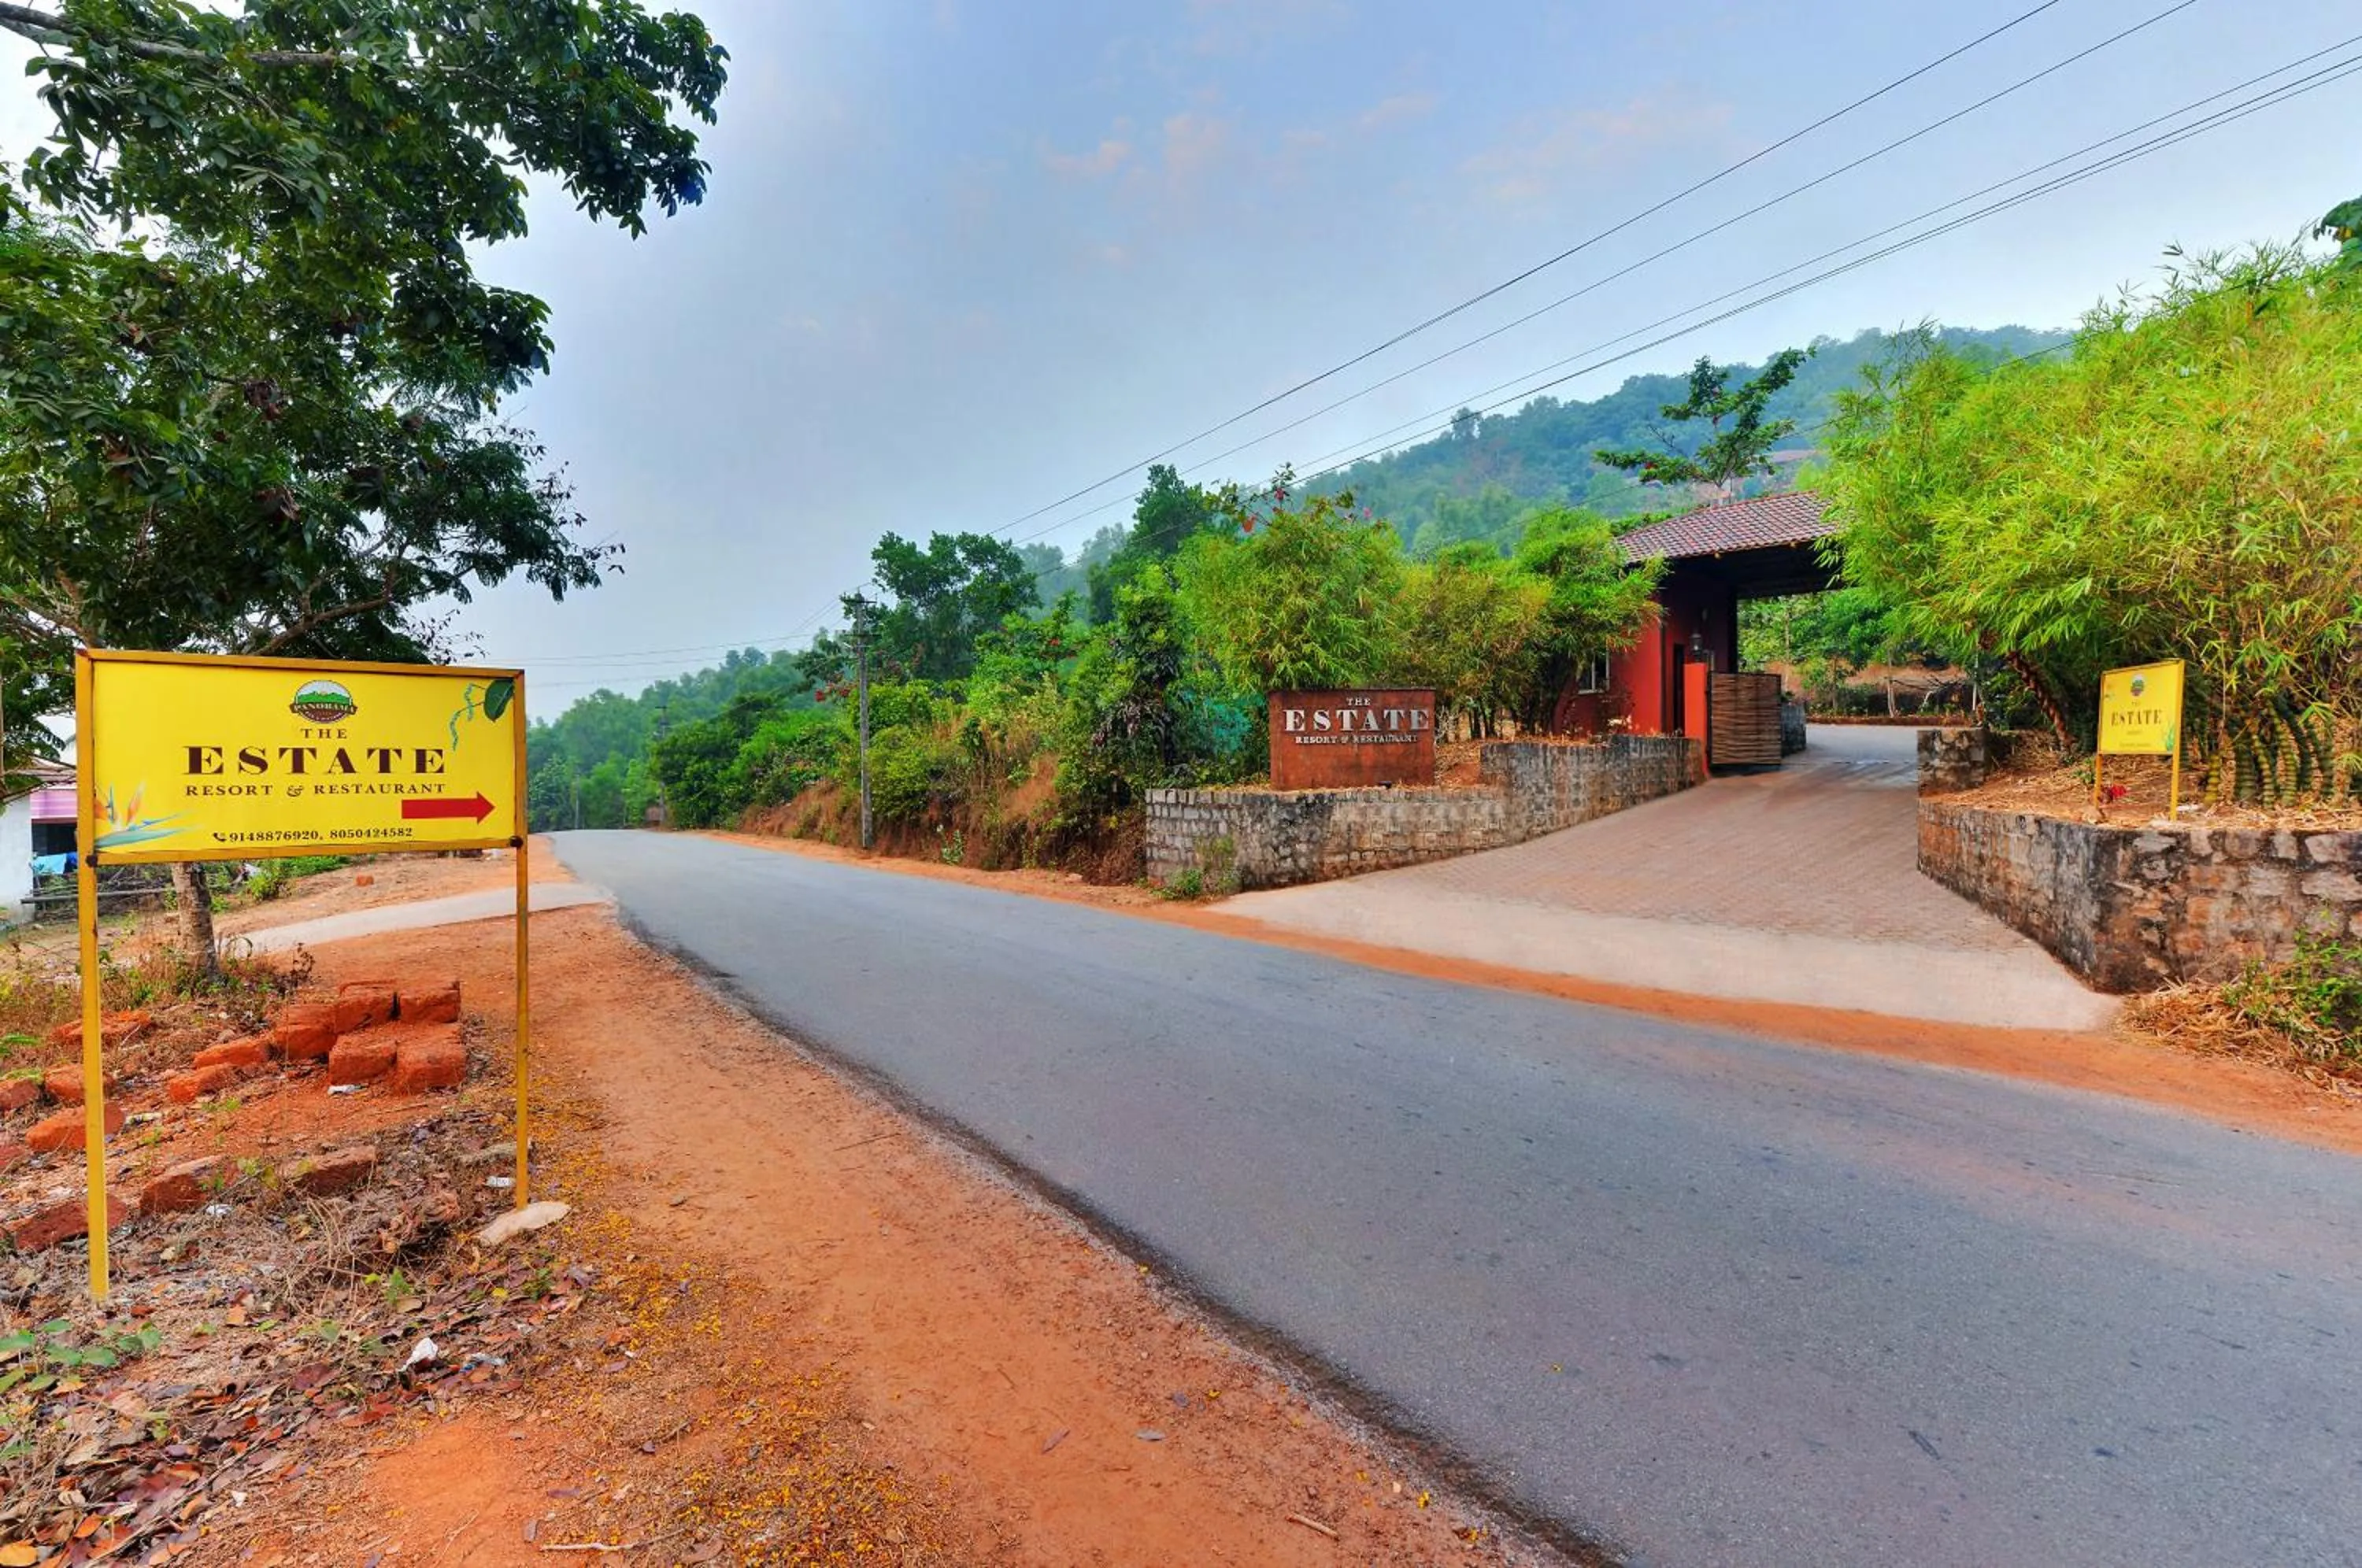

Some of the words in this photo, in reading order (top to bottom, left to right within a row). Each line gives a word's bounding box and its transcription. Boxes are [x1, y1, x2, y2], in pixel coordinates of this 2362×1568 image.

[1346, 697, 1371, 706] THE
[1283, 708, 1429, 732] ESTATE
[2111, 708, 2163, 727] ESTATE
[301, 728, 347, 739] THE
[1295, 735, 1338, 744] RESORT
[1353, 734, 1418, 744] RESTAURANT
[183, 745, 446, 775] ESTATE
[186, 784, 272, 797] RESORT
[287, 785, 304, 797] &
[314, 782, 446, 794] RESTAURANT
